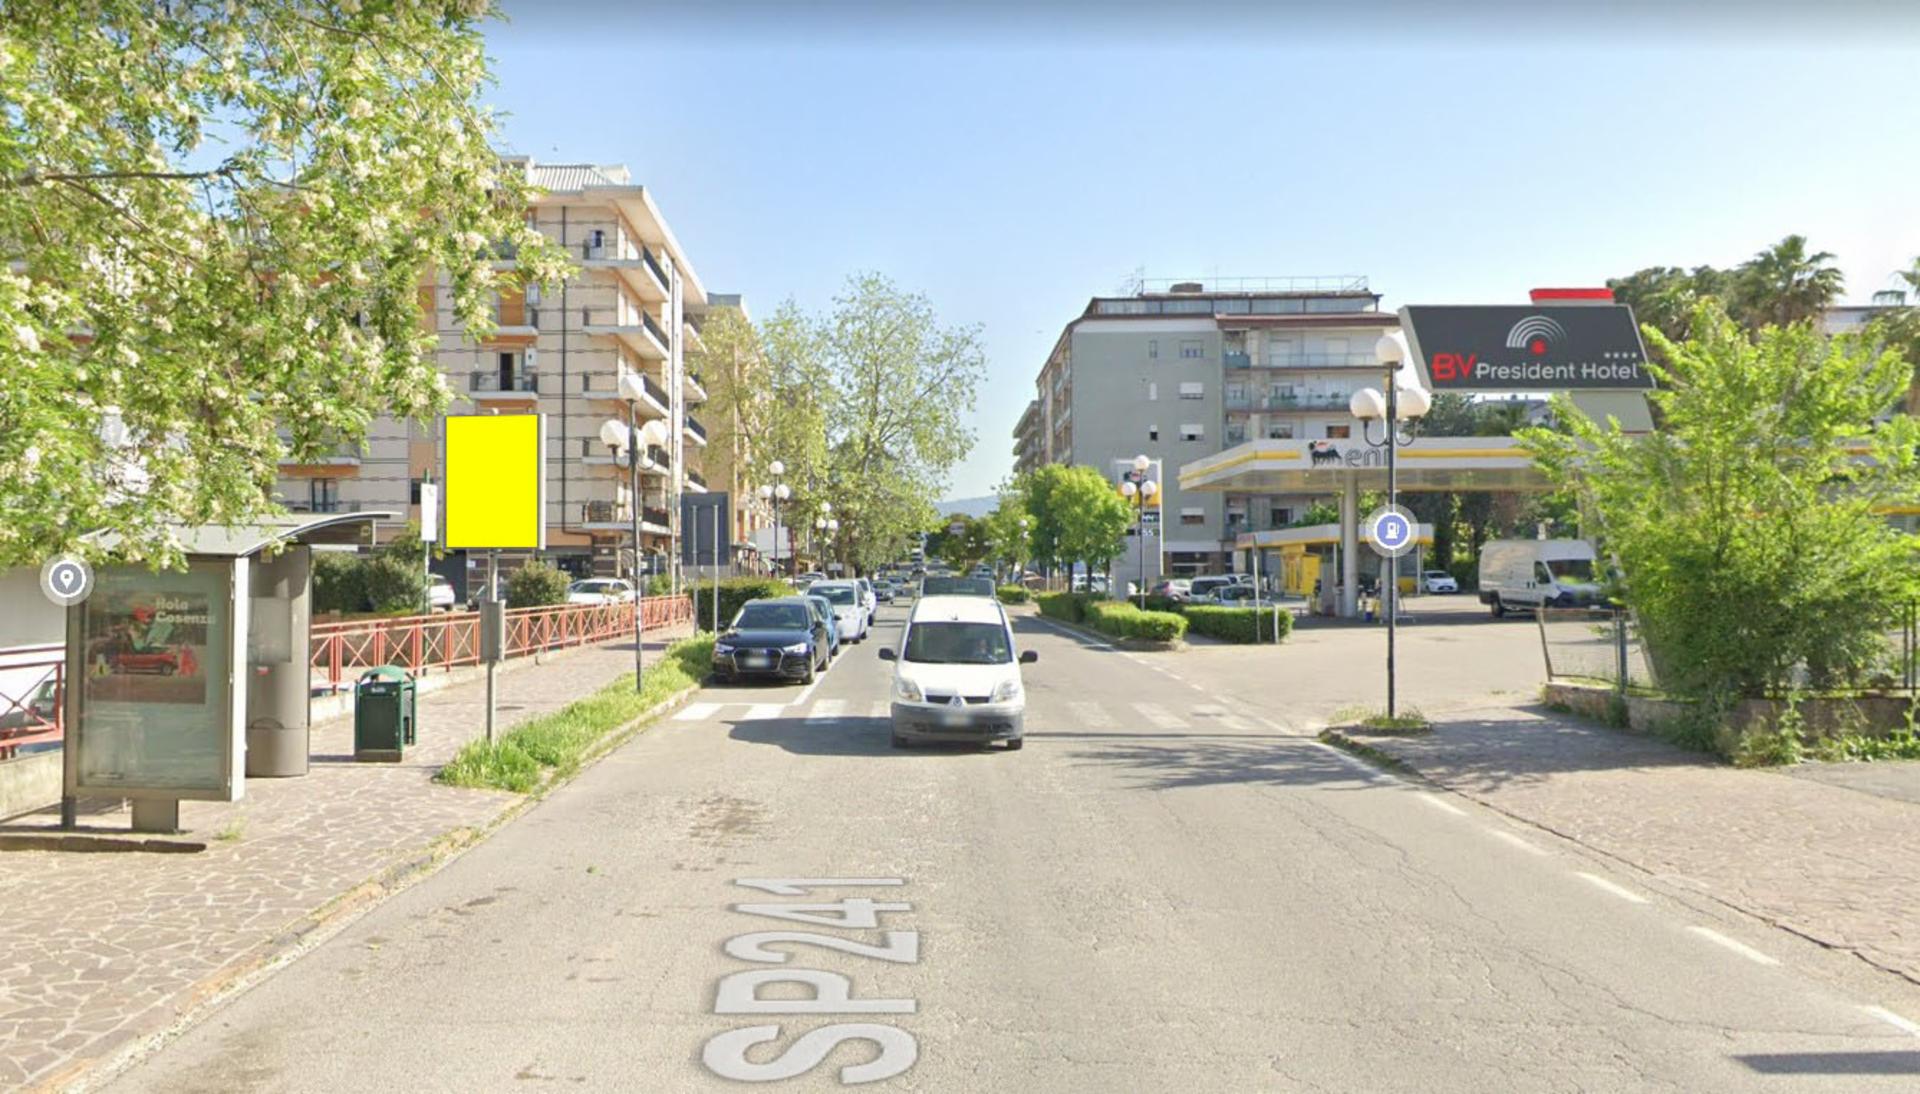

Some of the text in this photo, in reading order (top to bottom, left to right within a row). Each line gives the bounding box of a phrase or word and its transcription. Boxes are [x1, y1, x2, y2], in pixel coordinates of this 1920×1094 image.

[1431, 353, 1639, 380] BV President Hotel
[155, 597, 189, 610] Hola
[155, 611, 216, 624] Cosenza
